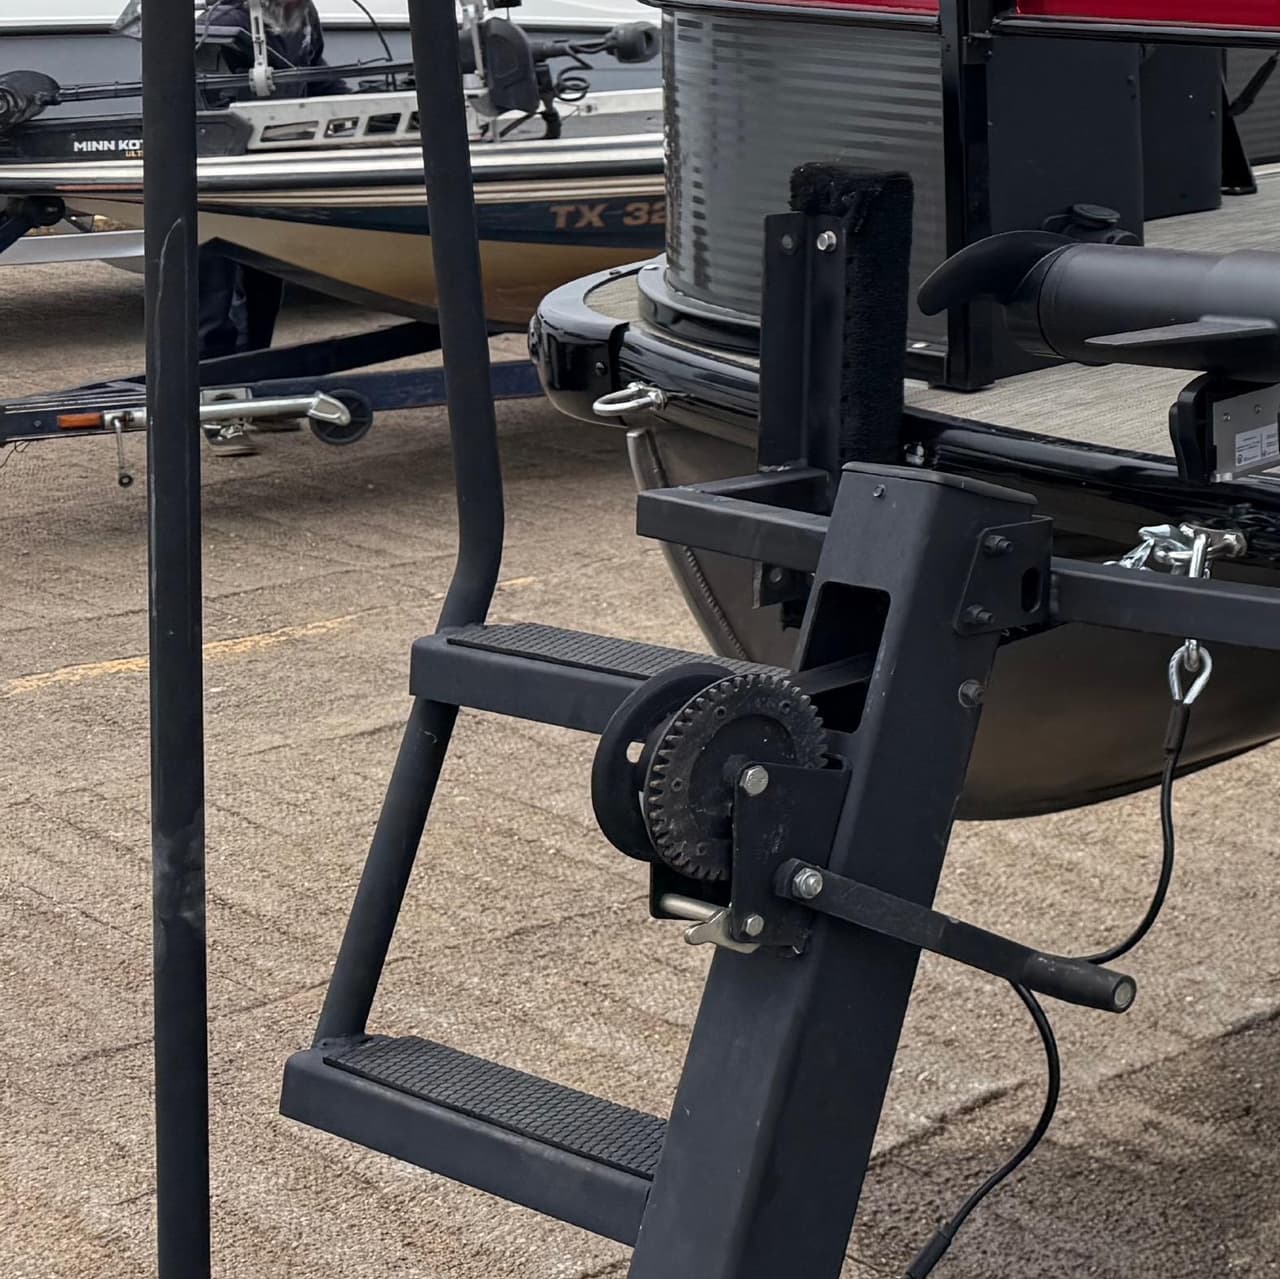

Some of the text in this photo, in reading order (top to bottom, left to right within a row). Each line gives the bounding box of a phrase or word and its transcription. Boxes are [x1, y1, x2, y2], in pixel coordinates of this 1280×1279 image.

[73, 140, 116, 152] MINN
[125, 150, 144, 158] ULT
[549, 203, 608, 229] TX
